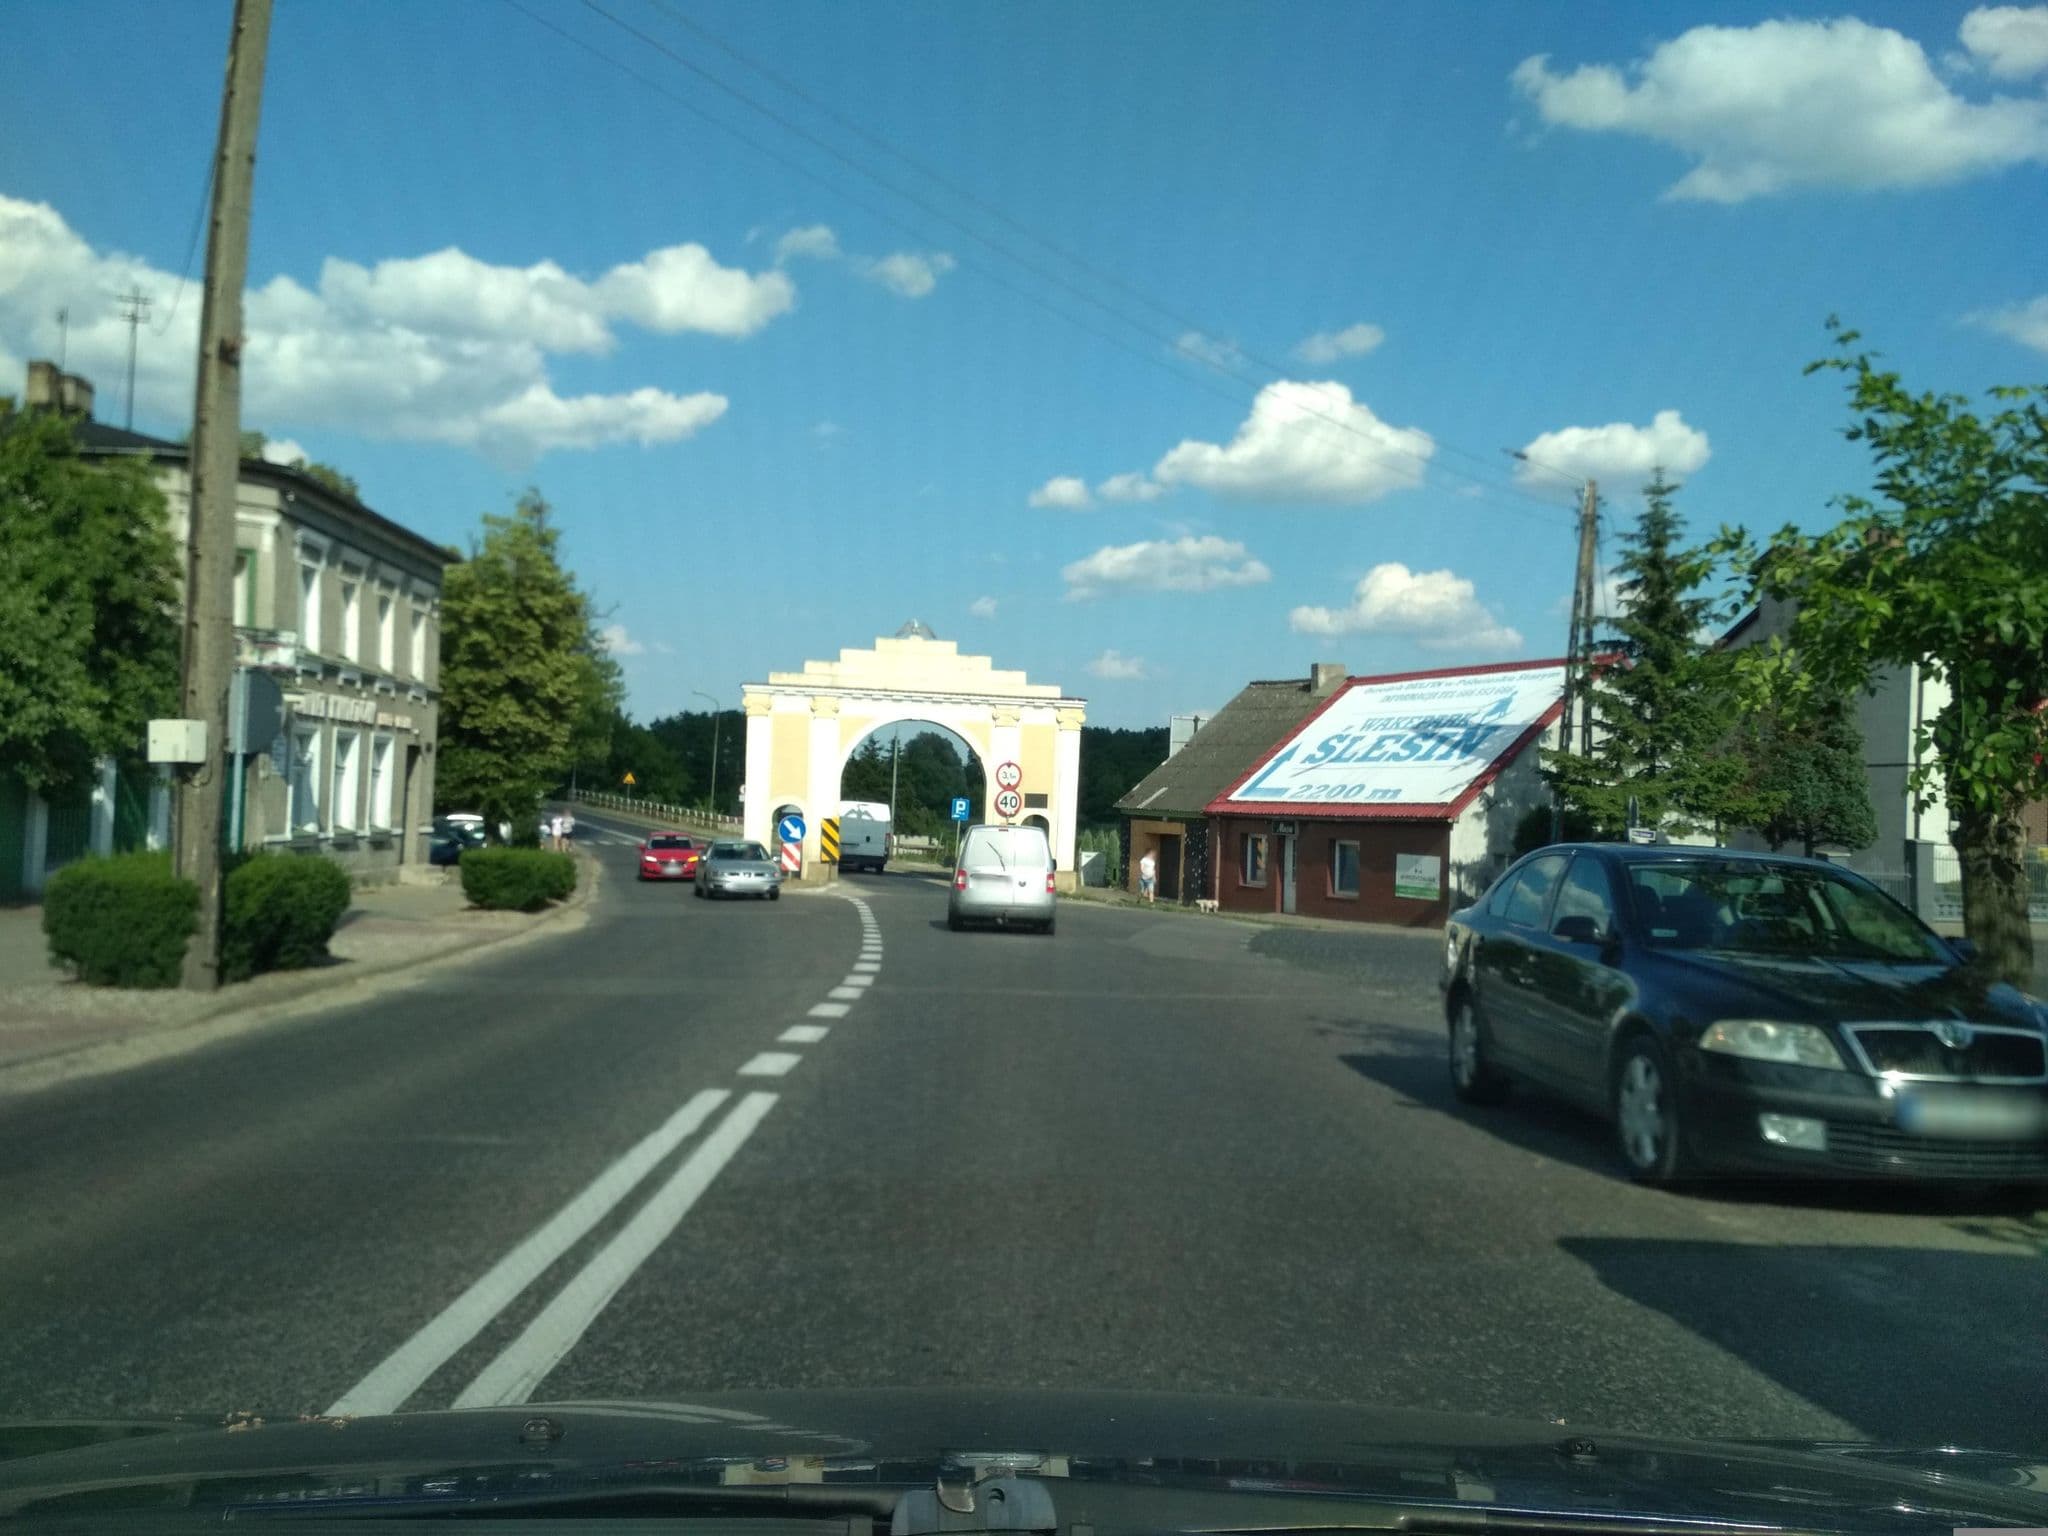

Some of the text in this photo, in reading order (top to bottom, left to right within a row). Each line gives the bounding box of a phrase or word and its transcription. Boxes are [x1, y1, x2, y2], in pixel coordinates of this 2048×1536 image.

[1360, 713, 1474, 731] WAKEPARK
[1302, 725, 1501, 764] ŚLESIN
[1288, 784, 1401, 799] 2200 m
[956, 800, 966, 814] P
[1000, 796, 1018, 808] 40
